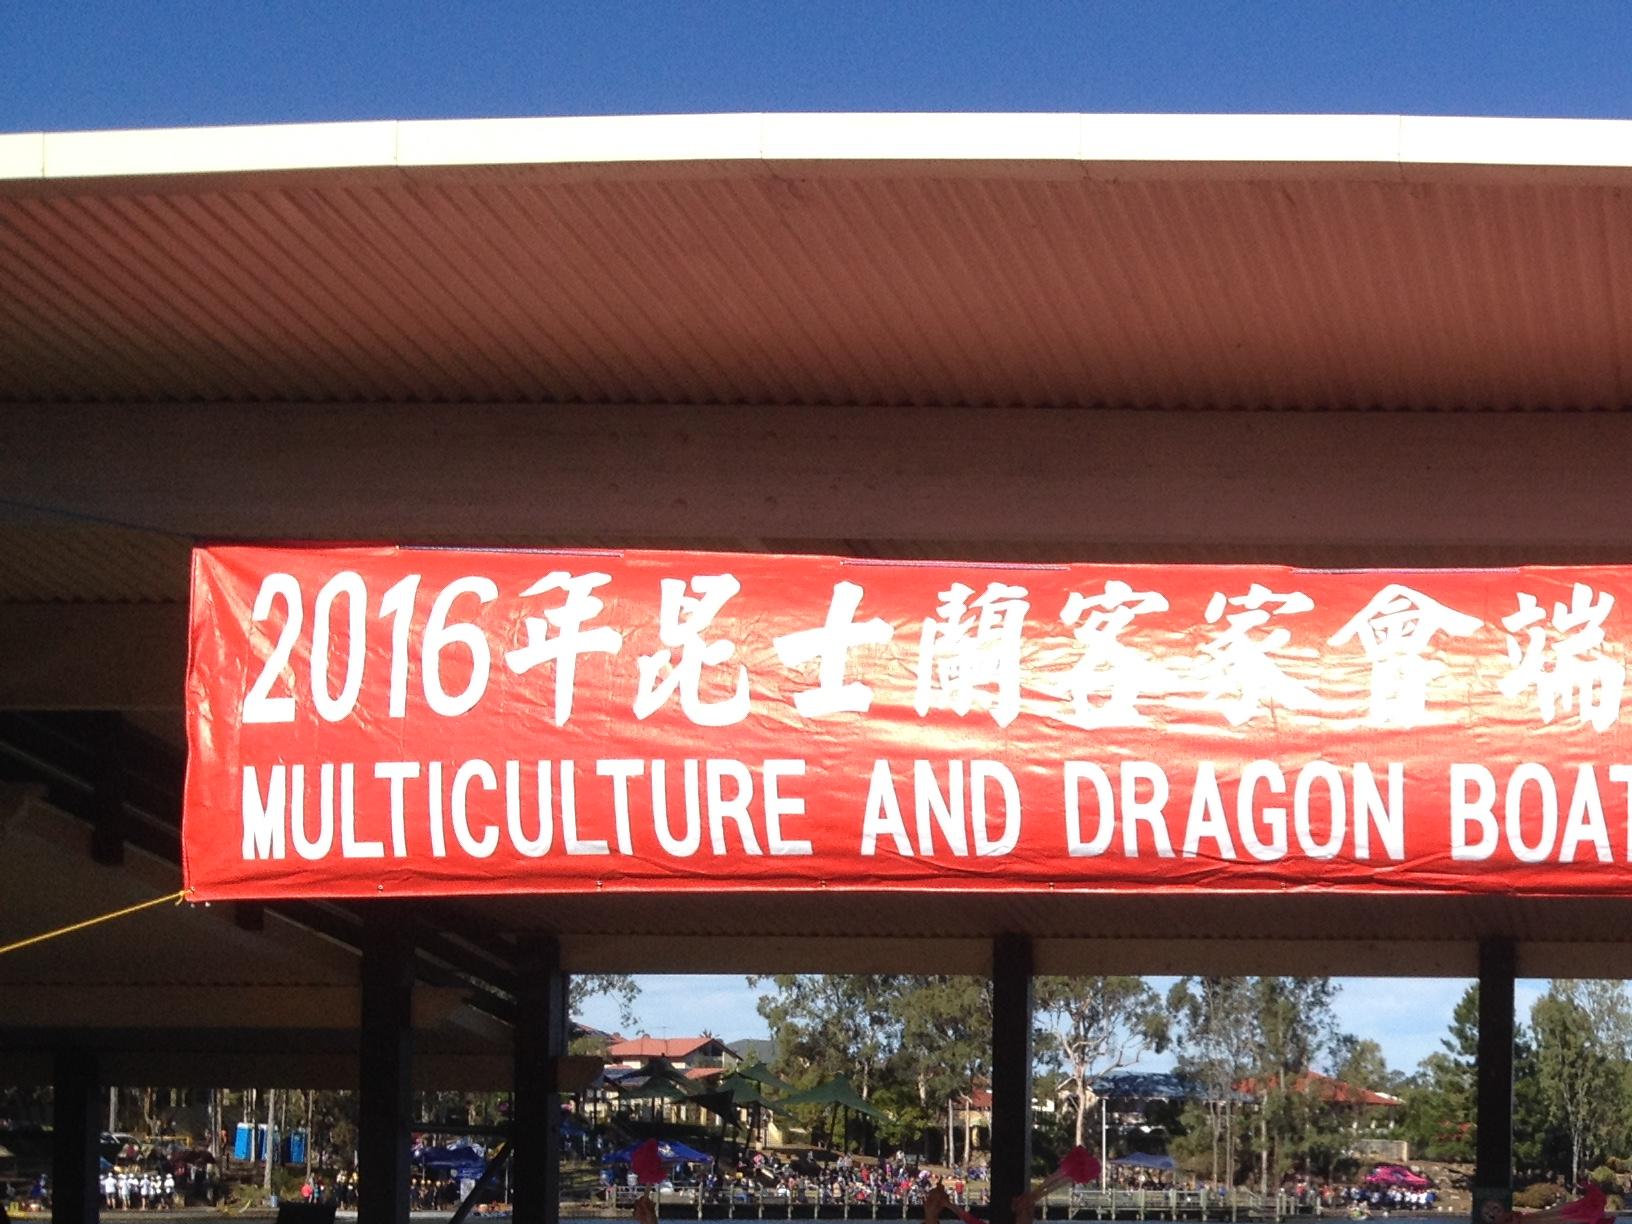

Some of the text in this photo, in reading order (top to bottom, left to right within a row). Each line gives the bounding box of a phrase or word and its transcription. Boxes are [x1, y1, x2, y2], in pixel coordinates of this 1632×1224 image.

[241, 757, 813, 861] MULTICULTURE
[859, 756, 1022, 857] AND
[1064, 758, 1405, 863] DRAGON
